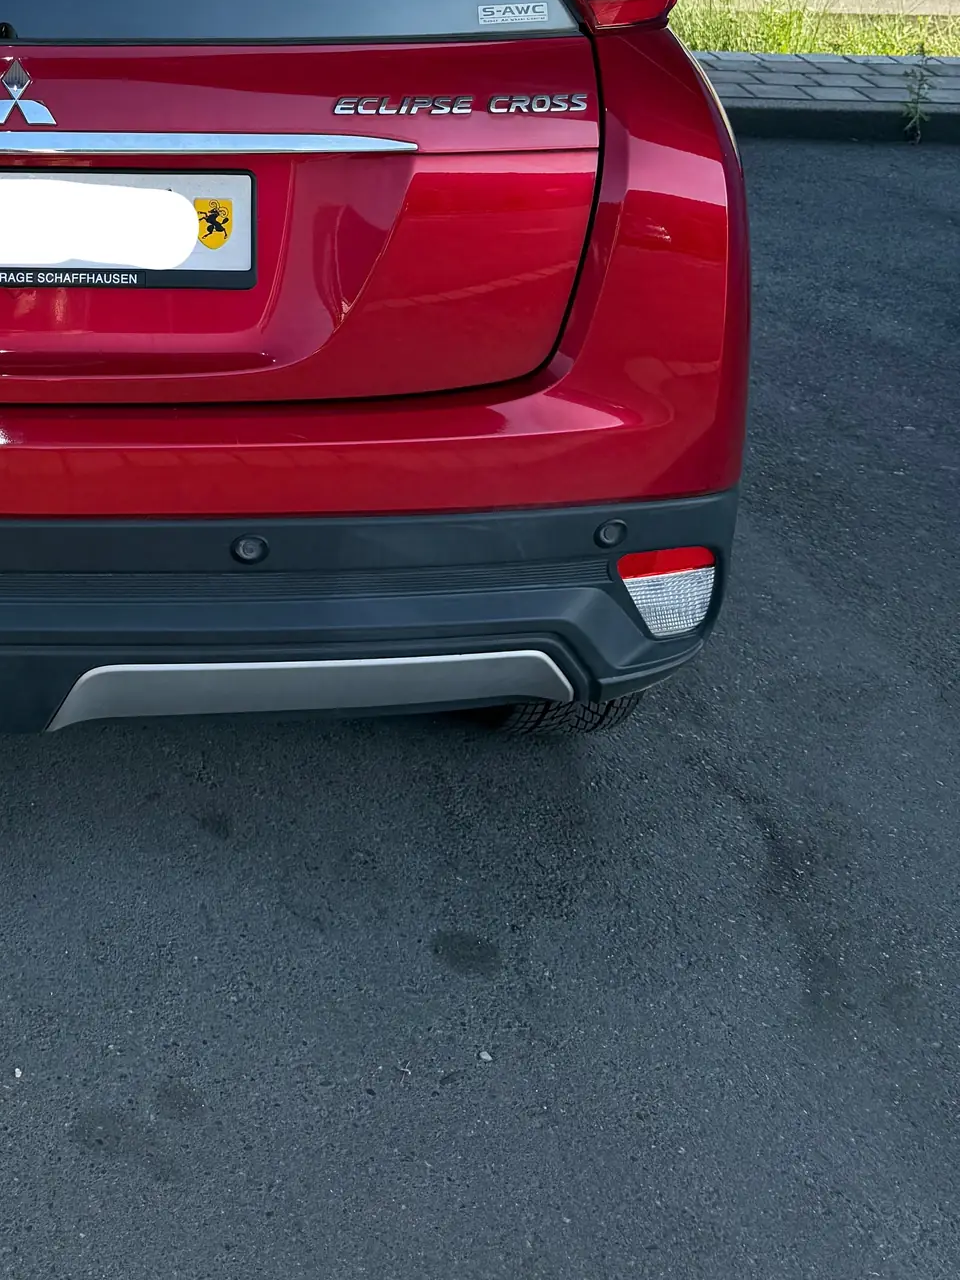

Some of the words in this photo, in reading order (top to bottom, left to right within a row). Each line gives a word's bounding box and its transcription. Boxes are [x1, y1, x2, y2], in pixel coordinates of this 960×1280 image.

[482, 4, 545, 17] S-AWC
[333, 95, 474, 116] ECLIPSE
[489, 93, 588, 114] CROSS
[37, 272, 138, 285] SCHAFFHAUSEN
